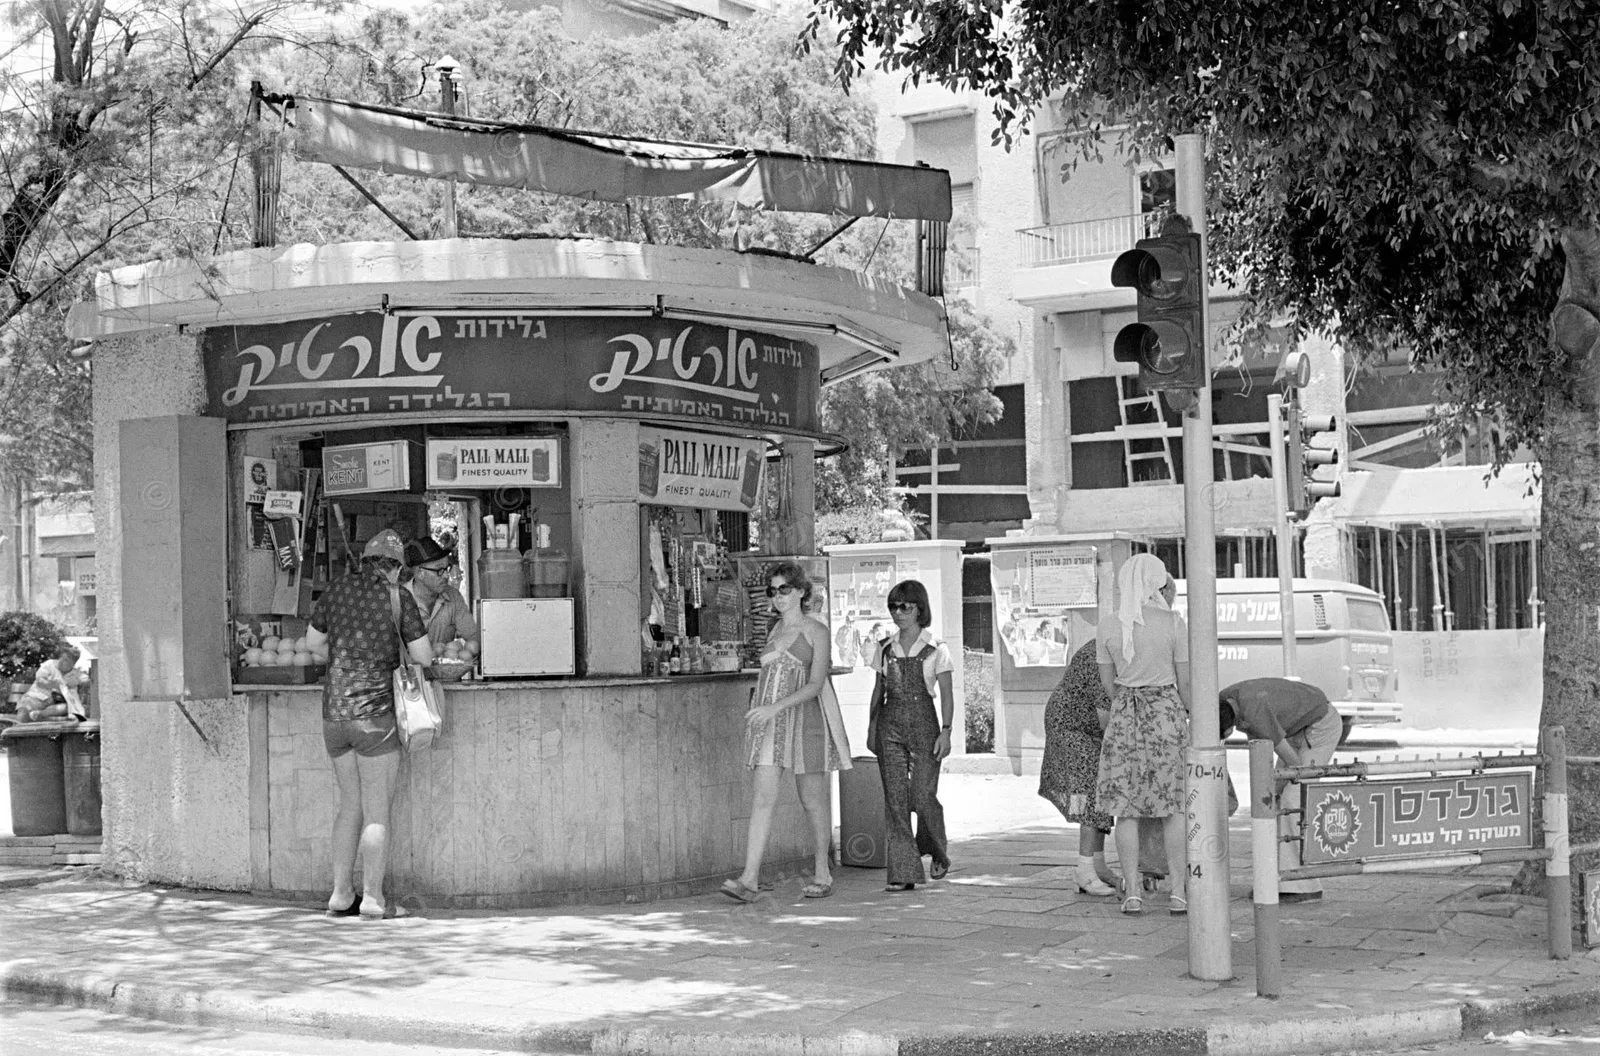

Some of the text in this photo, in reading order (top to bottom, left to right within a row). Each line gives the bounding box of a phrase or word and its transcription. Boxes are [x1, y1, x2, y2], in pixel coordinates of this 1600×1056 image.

[454, 315, 548, 339] גלידות
[221, 315, 443, 407] ארטיק
[588, 326, 759, 393] ארטיק
[762, 342, 802, 368] גלידות
[247, 385, 511, 420] הגלידה האמיתית
[620, 394, 790, 426] הגלידה האמיתית
[373, 458, 390, 466] KENT
[460, 447, 530, 464] PALL MALL
[663, 438, 741, 481] PALL MALL
[327, 468, 365, 486] KENT
[461, 468, 528, 477] FINEST QUALITY
[665, 485, 732, 499] FINEST QUALITY
[279, 545, 293, 568] MAX
[1241, 598, 1281, 622] פעלי
[1186, 763, 1224, 780] 70-14
[1369, 779, 1521, 848] גולדסן
[1391, 824, 1521, 846] משקה קל טבעי
[1187, 863, 1202, 879] 14
